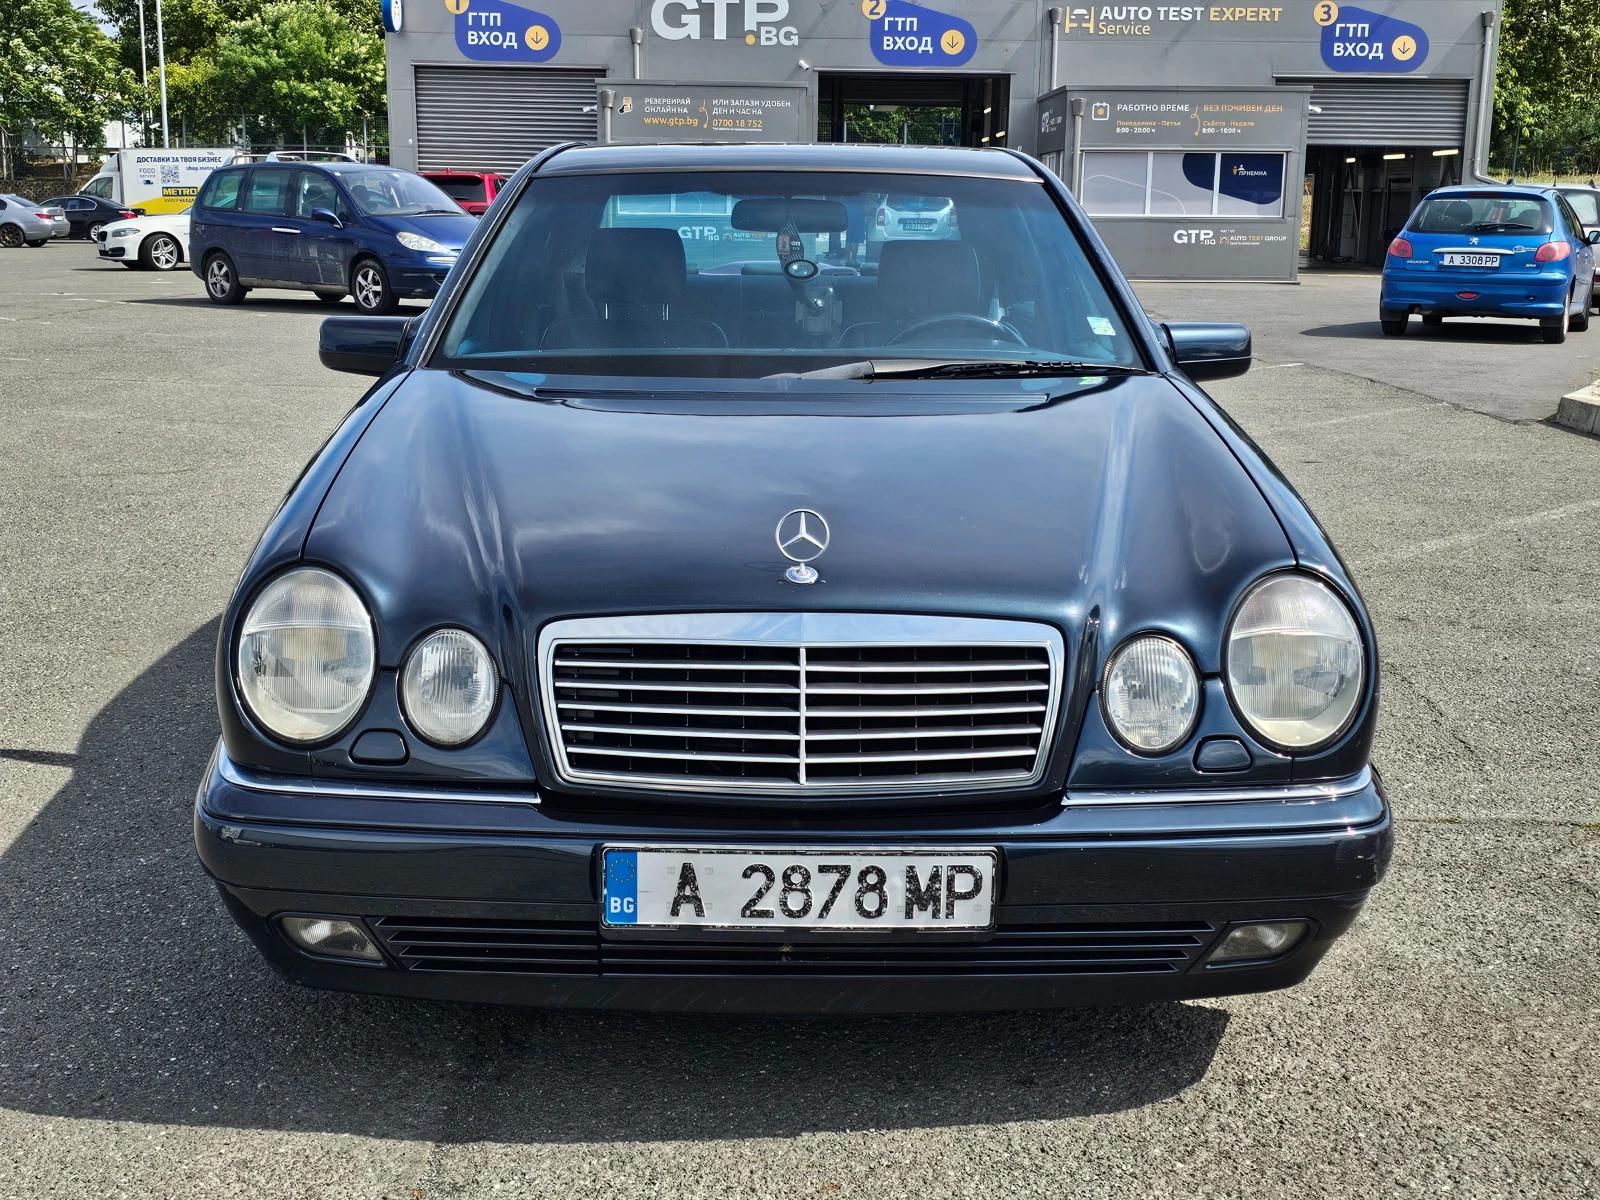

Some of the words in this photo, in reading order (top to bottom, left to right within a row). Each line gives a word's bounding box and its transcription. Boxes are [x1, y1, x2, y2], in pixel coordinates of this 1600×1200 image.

[868, 0, 880, 15] 2
[1100, 6, 1152, 21] AUTO
[1157, 6, 1204, 21] TEST
[1209, 7, 1283, 22] EXPERT
[1320, 4, 1332, 22] 3
[468, 12, 501, 27] ГТП
[884, 17, 918, 31] ГТП
[1098, 21, 1151, 35] Service
[1335, 23, 1370, 37] ГТП
[467, 31, 518, 49] ВХОД
[883, 36, 933, 54] ВХОД
[1333, 42, 1384, 60] ВХОД
[644, 97, 691, 105] РЕЗЕРВИРАЙ
[730, 99, 760, 107] ЗАПАЗИ
[761, 100, 791, 108] УДОБЕН
[1117, 104, 1159, 112] РАБОТНО
[1160, 104, 1190, 112] ВРЕМЕ
[644, 106, 676, 114] ОНЛАЙН
[712, 107, 728, 115] ДЕН
[1203, 104, 1219, 112] БЕЗ
[1221, 104, 1263, 112] ПОЧИВЕН
[1264, 104, 1283, 113] ДЕН
[643, 116, 699, 127] www.gtp.bg
[712, 119, 733, 127] 0700
[735, 119, 745, 127] 18
[747, 119, 763, 128] 752
[136, 156, 171, 164] ДОСТАВКИ
[163, 187, 198, 196] METRO
[1448, 255, 1455, 265] A
[1459, 255, 1484, 266] 3308
[1484, 256, 1498, 266] PP
[669, 862, 706, 917] A
[740, 863, 889, 920] 2878
[904, 864, 983, 920] MP
[609, 897, 635, 914] BG
